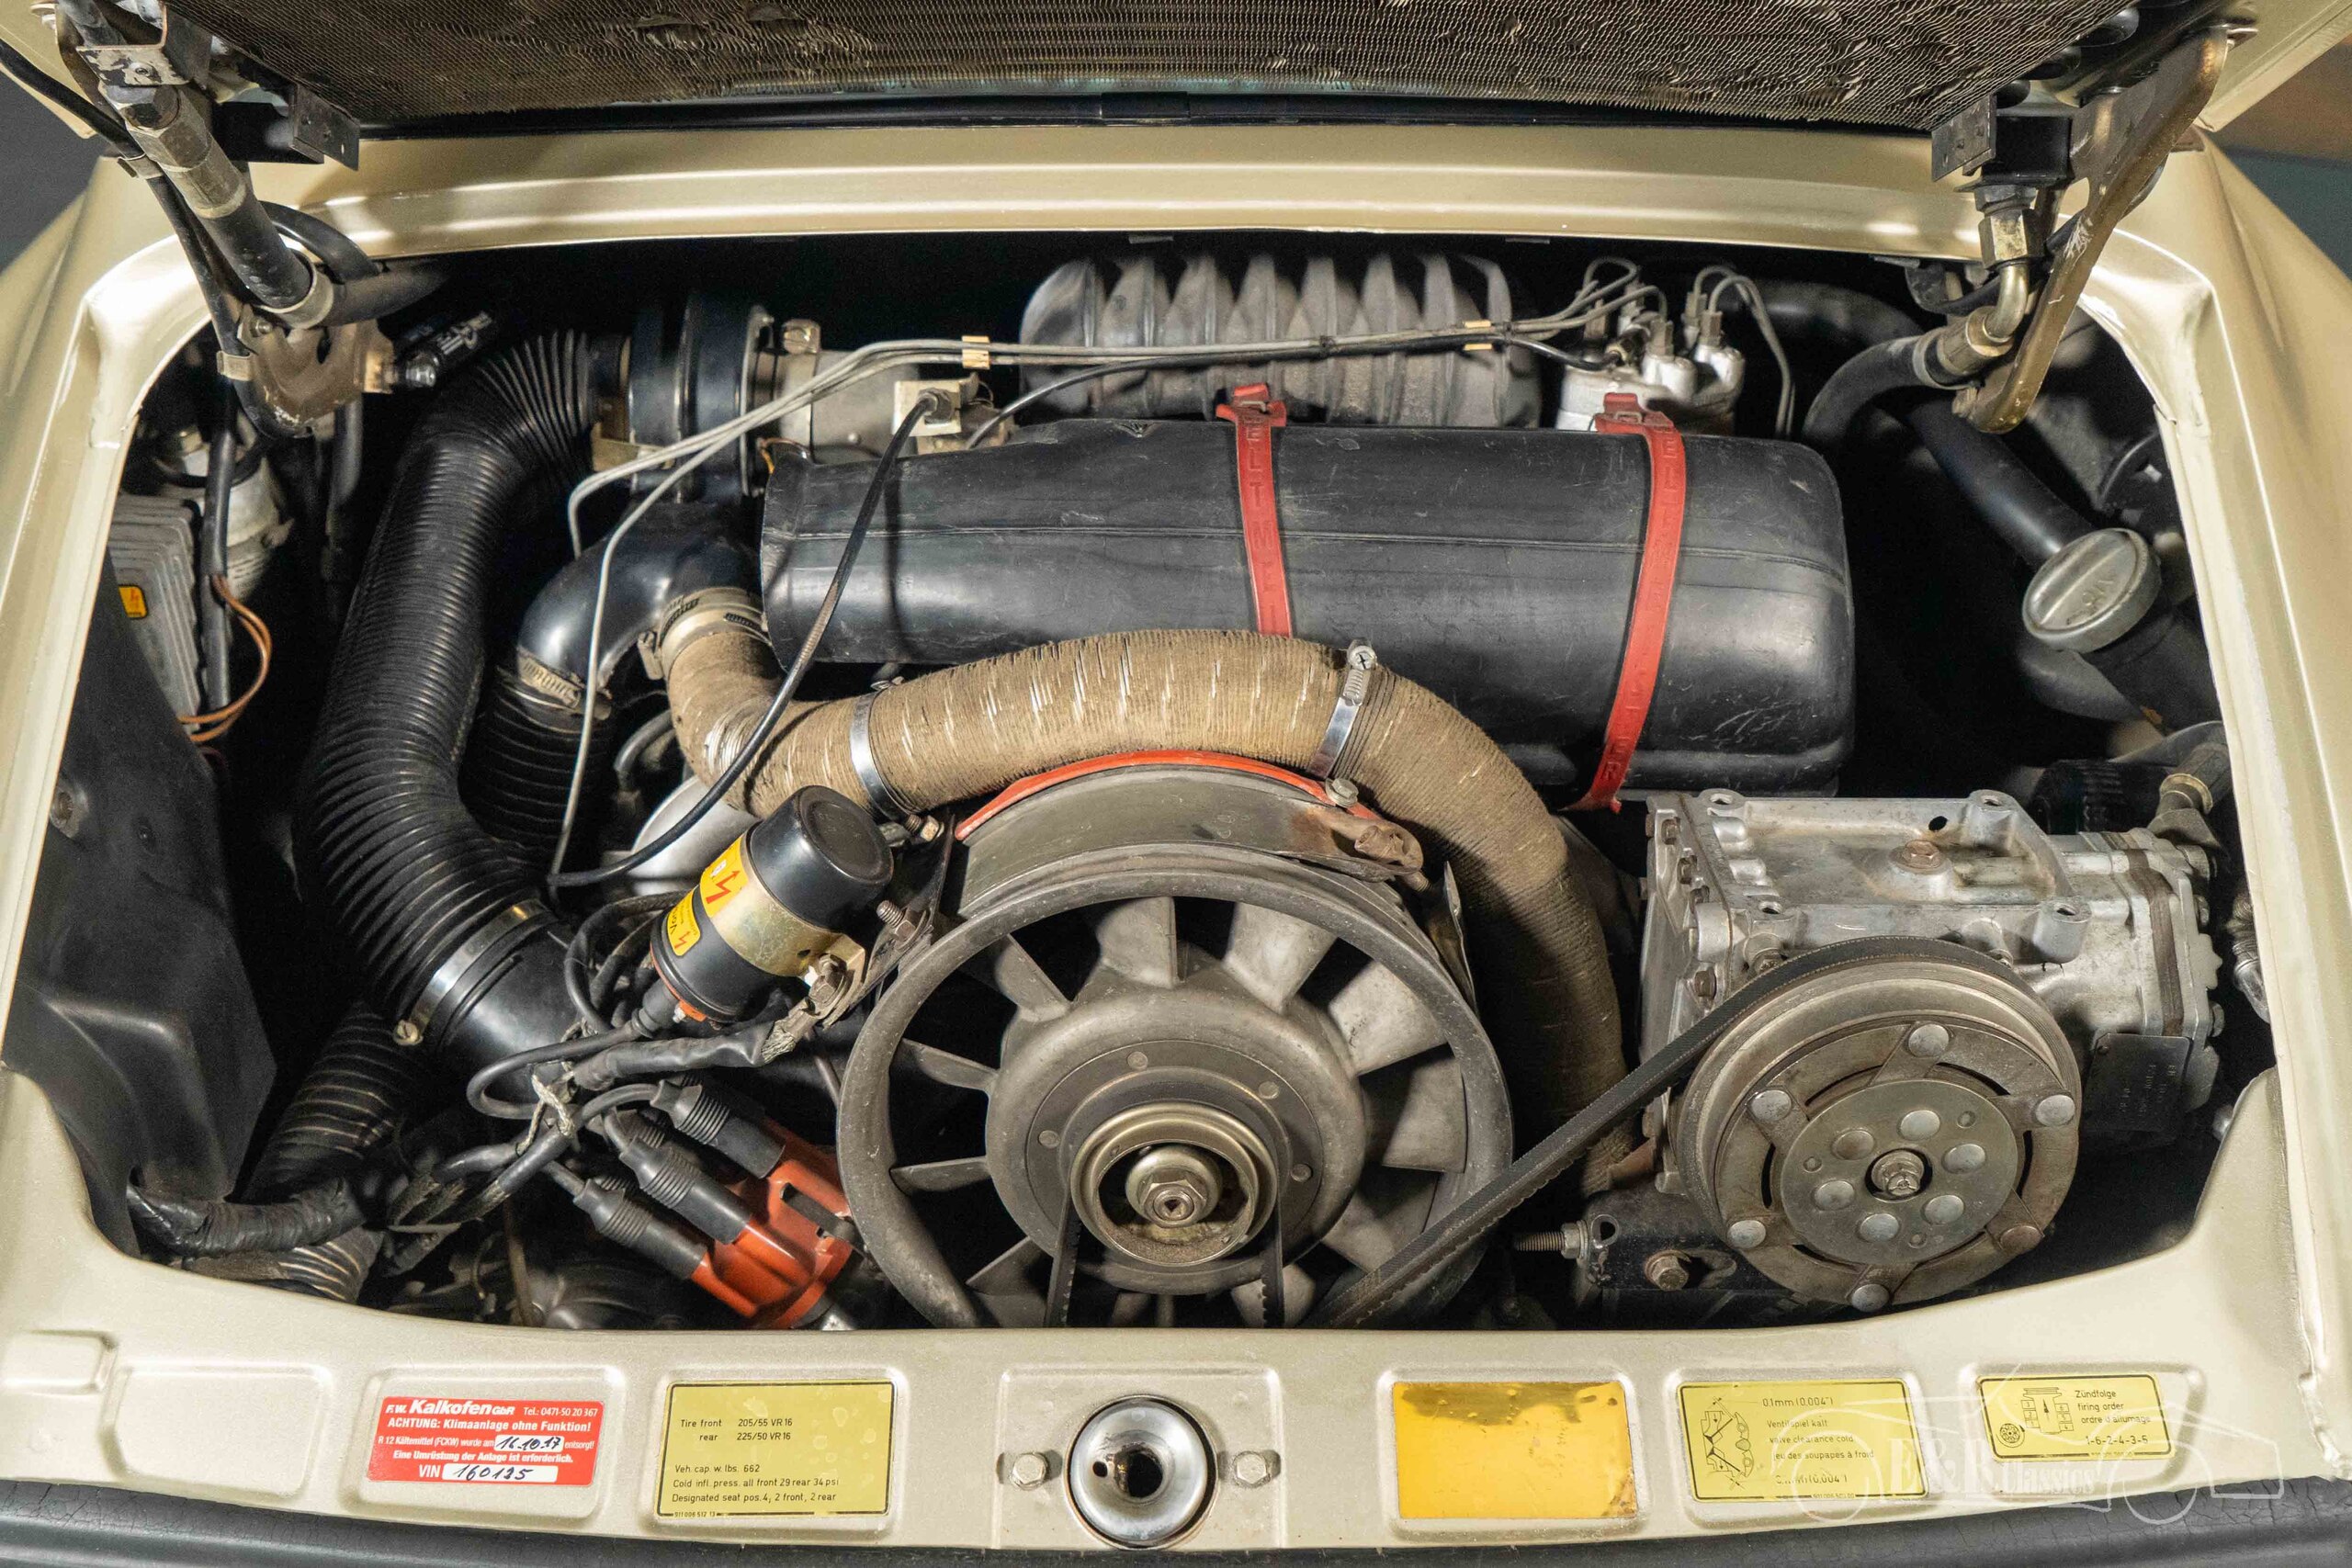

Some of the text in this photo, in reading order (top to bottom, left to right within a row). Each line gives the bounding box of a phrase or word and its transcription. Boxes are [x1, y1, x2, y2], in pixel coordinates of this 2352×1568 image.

[409, 1399, 492, 1415] Kalkofen
[571, 1407, 582, 1416] 20
[583, 1407, 598, 1417] 367
[2077, 1403, 2124, 1412] firing order
[388, 1417, 591, 1432] ACHTUNG: Klimaanlage ohne Funktion!
[681, 1418, 722, 1427] Tire front
[738, 1417, 793, 1427] 205/55 VR 16
[1811, 1419, 1828, 1427] kalt
[736, 1431, 791, 1441] 225/50 VR 16
[1837, 1435, 1854, 1443] cold
[378, 1436, 384, 1445] R
[386, 1436, 395, 1445] 12
[460, 1438, 482, 1447] wurde
[483, 1439, 494, 1448] am
[392, 1450, 574, 1463] Eine Umrüstung der Anlage ist erforderlich.
[1787, 1450, 1802, 1460] des
[1804, 1451, 1845, 1461] soupapes
[418, 1464, 441, 1478] VIN
[743, 1463, 761, 1472] 662
[673, 1479, 693, 1488] Cold
[742, 1478, 753, 1487] all
[756, 1477, 778, 1486] front
[779, 1478, 790, 1486] 29
[813, 1477, 823, 1486] 34
[825, 1479, 839, 1487] psi
[672, 1494, 719, 1505] Designated
[722, 1493, 741, 1502] seat
[775, 1493, 781, 1502] 2
[783, 1493, 808, 1503] front,
[810, 1492, 816, 1502] 2
[817, 1494, 837, 1502] rear
